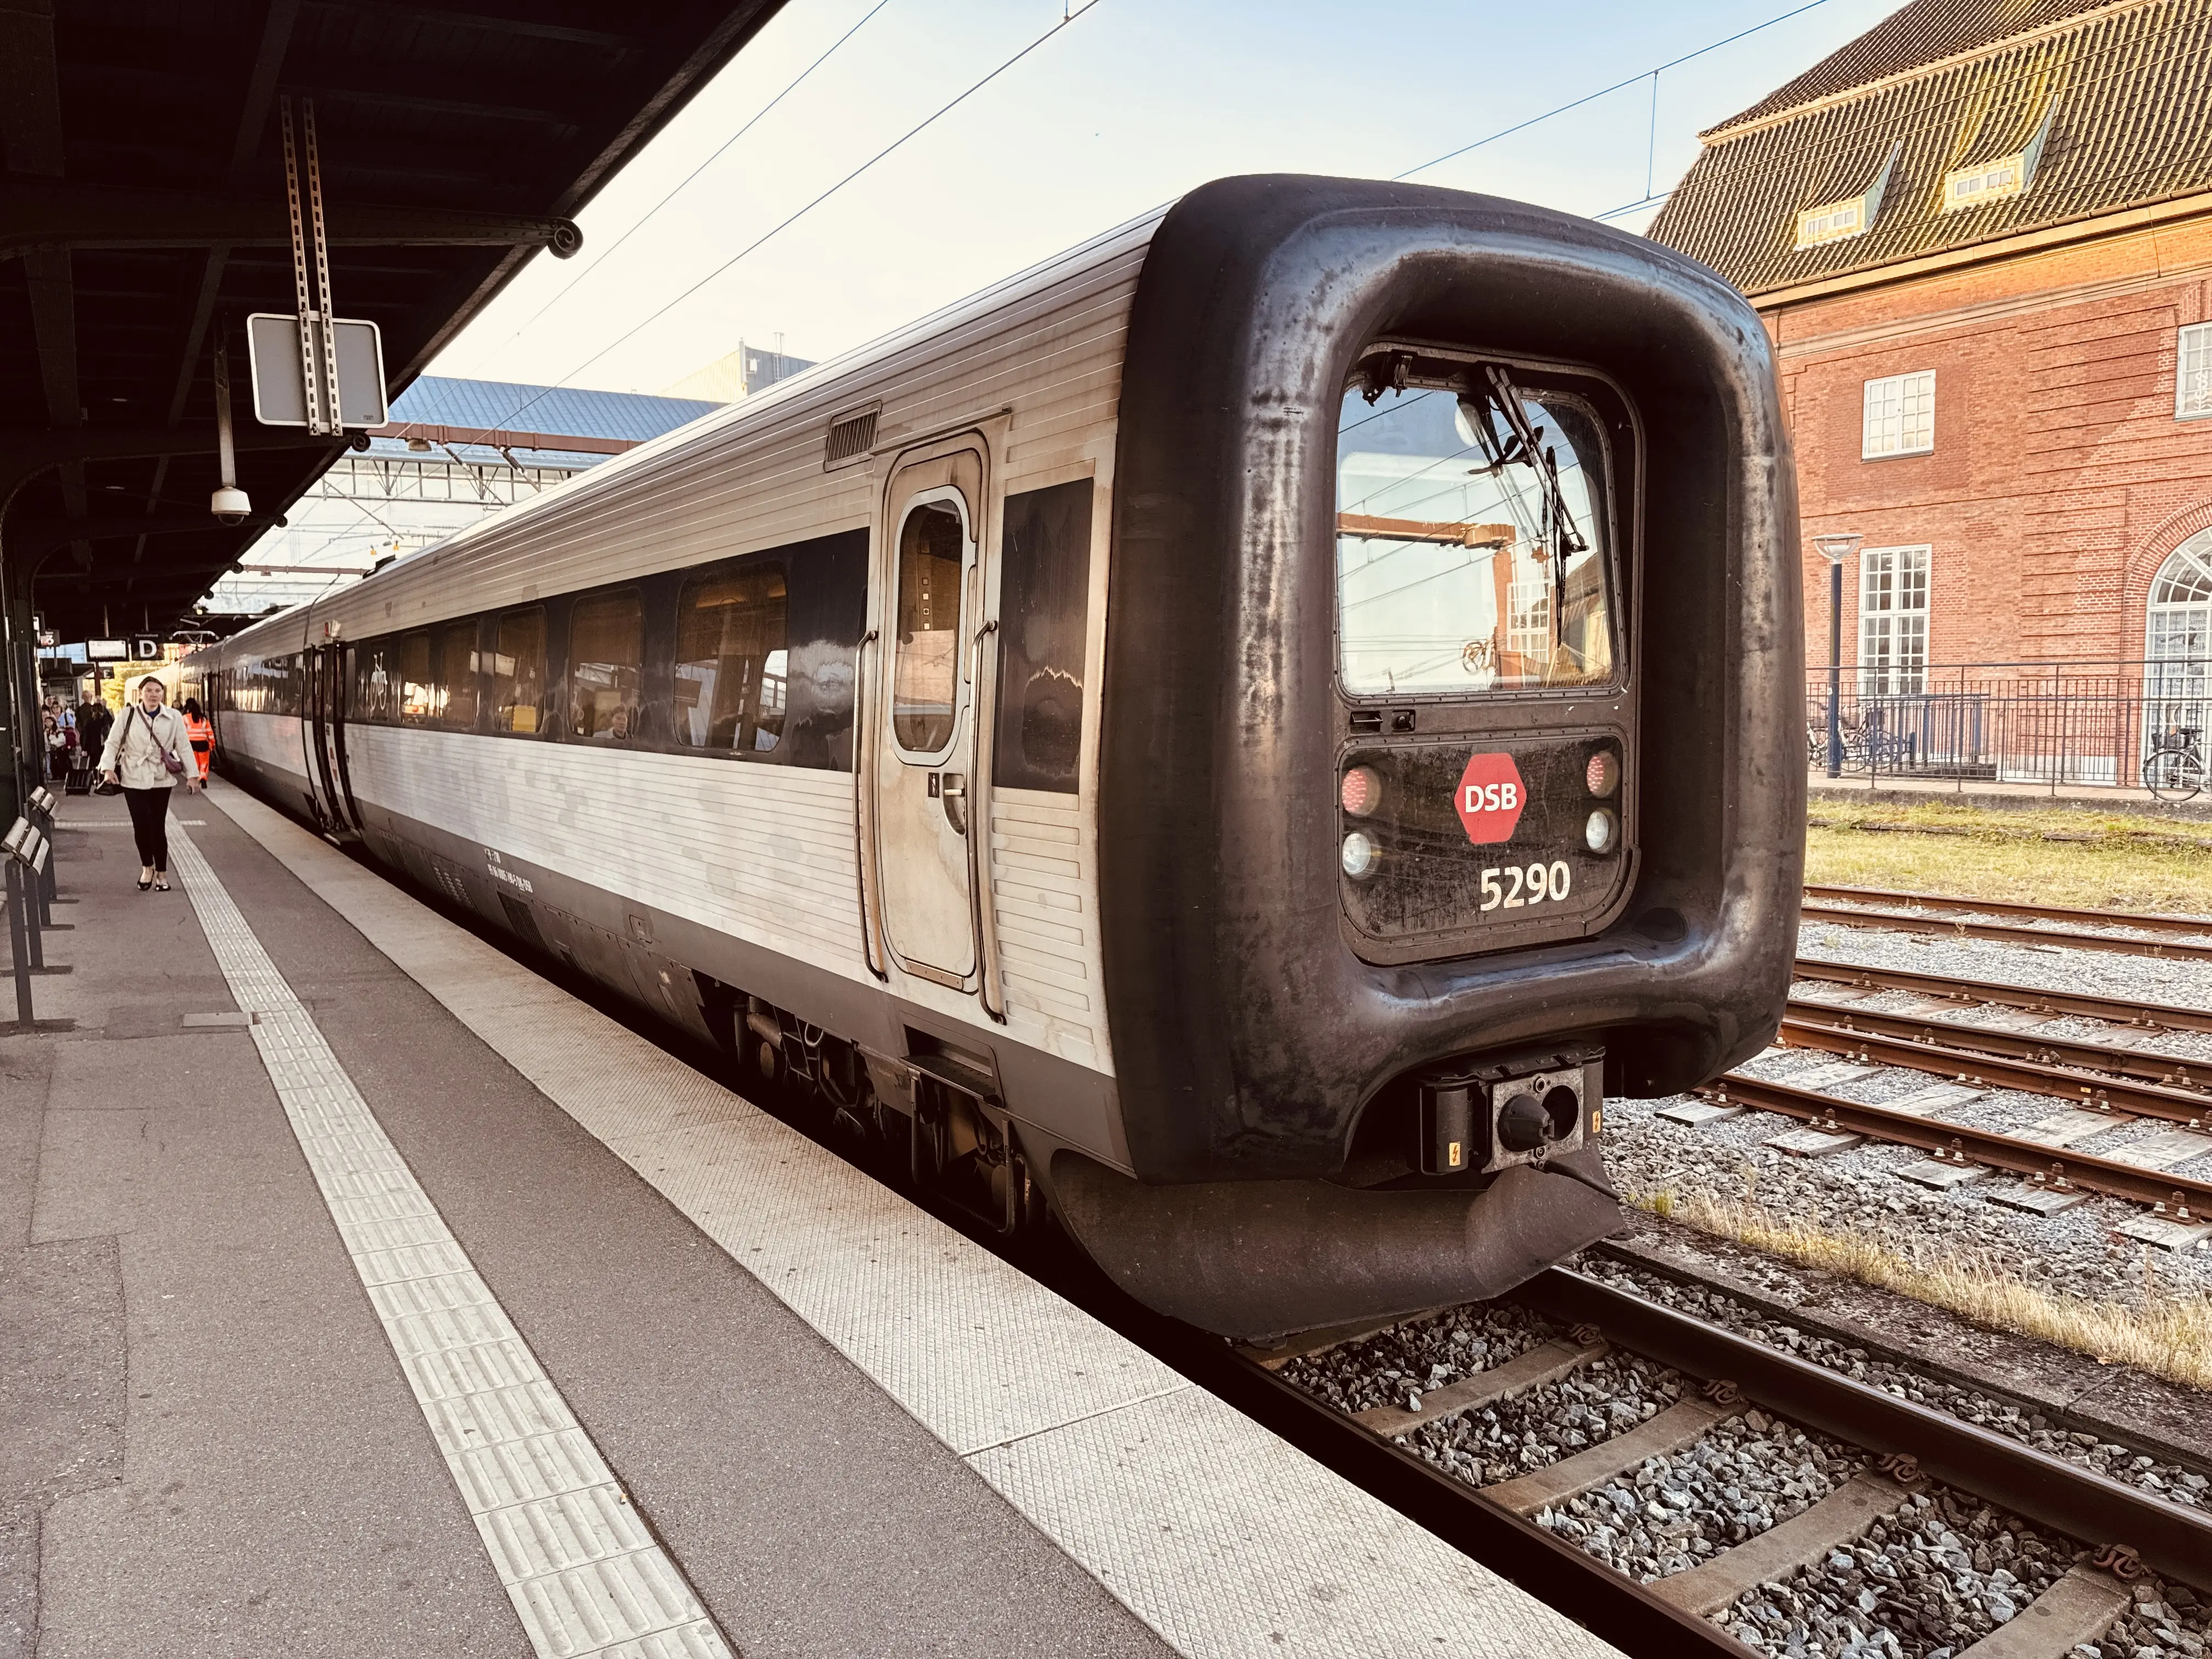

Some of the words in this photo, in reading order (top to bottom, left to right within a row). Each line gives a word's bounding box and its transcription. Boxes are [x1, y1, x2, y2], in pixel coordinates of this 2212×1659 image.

[139, 640, 157, 658] D
[104, 670, 110, 678] E
[1465, 783, 1517, 813] DSB
[1480, 860, 1571, 911] 5290
